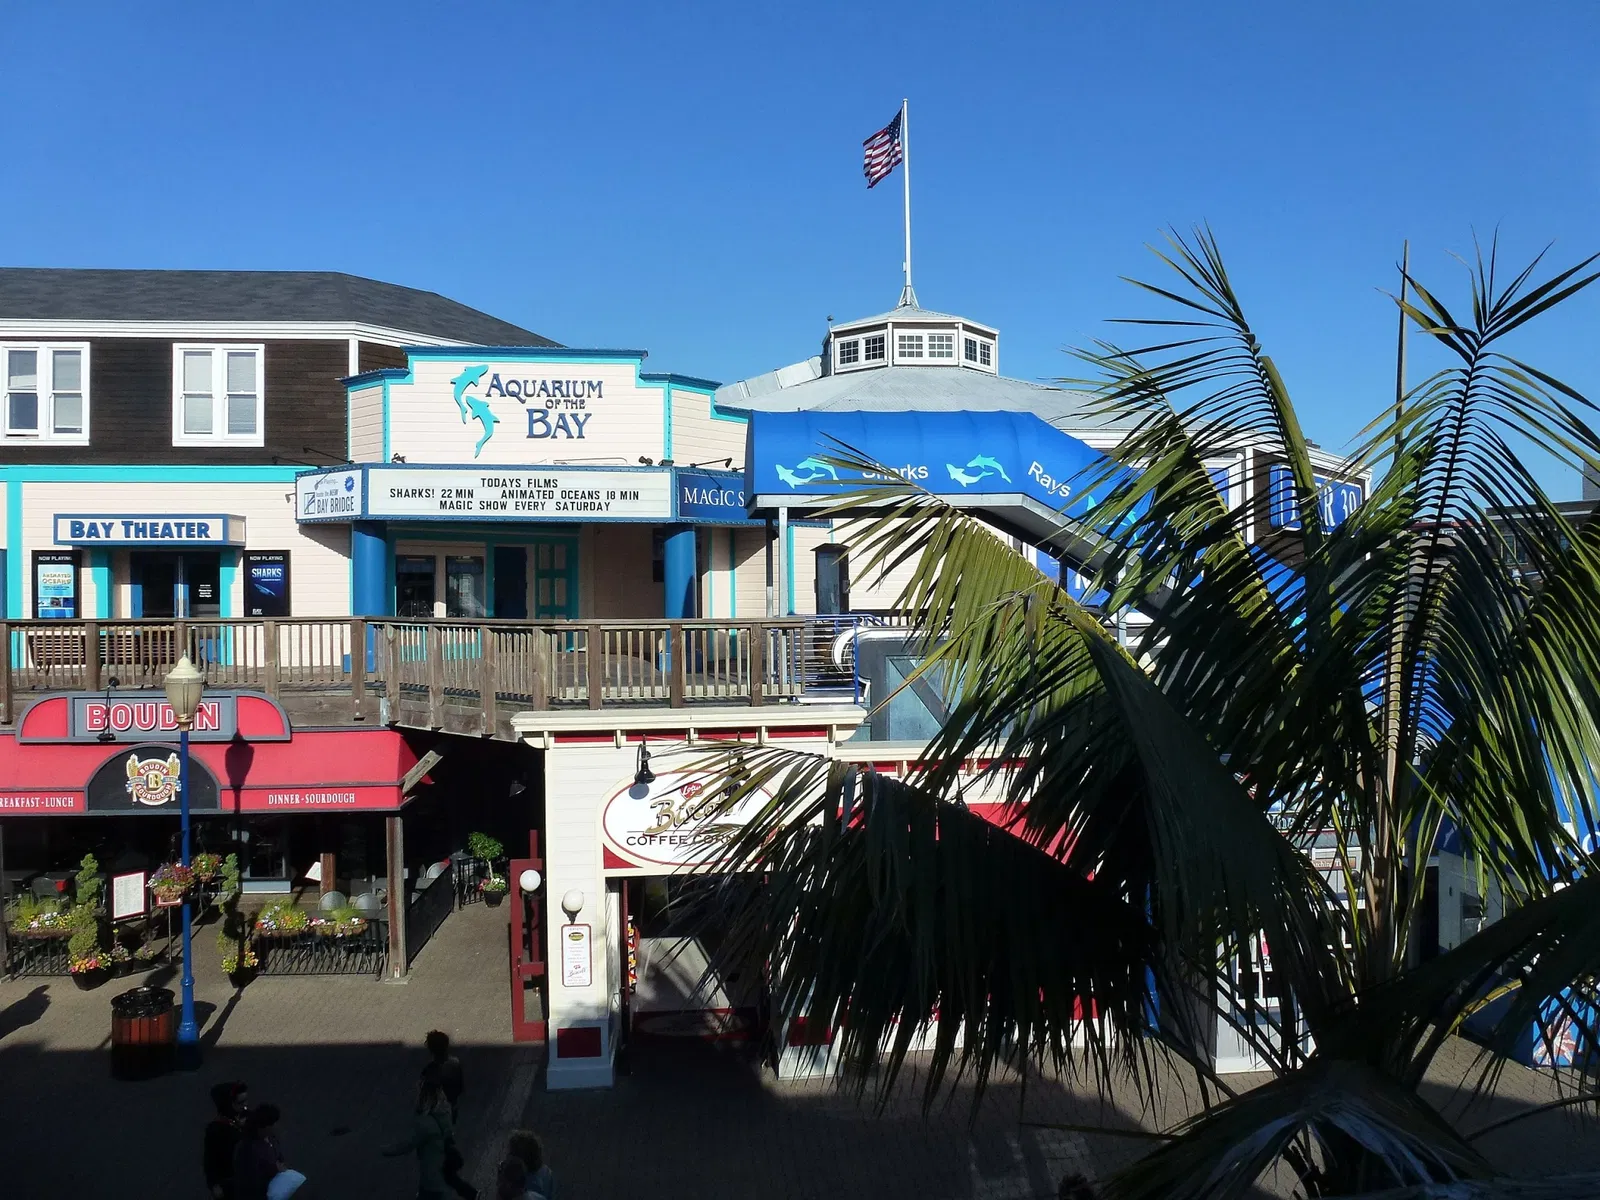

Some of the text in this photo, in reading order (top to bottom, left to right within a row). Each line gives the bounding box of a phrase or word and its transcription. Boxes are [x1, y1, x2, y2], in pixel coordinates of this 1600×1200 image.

[485, 373, 603, 404] AQUARIUM
[545, 399, 586, 410] OF THE
[526, 408, 592, 439] BAY
[480, 478, 558, 488] TODAYS FILMS
[1027, 460, 1071, 497] Rays
[390, 488, 435, 498] SHARKS!
[441, 489, 453, 498] 22
[455, 489, 474, 499] MIN
[501, 489, 554, 500] ANIMATED
[561, 490, 600, 500] OCEANS
[620, 490, 639, 500] MIN
[683, 486, 735, 507] MAGIC
[317, 496, 355, 514] BAY BRIDGE
[440, 500, 611, 511] MAGIC SHOW EVERY SATURDAY
[70, 520, 211, 539] BAY THEATER
[251, 568, 282, 578] SHARKS
[86, 702, 219, 731] BOUDN
[139, 763, 168, 775] BOUDIN
[135, 782, 172, 801] SOURDOUGH
[626, 835, 688, 846] COFFEE
